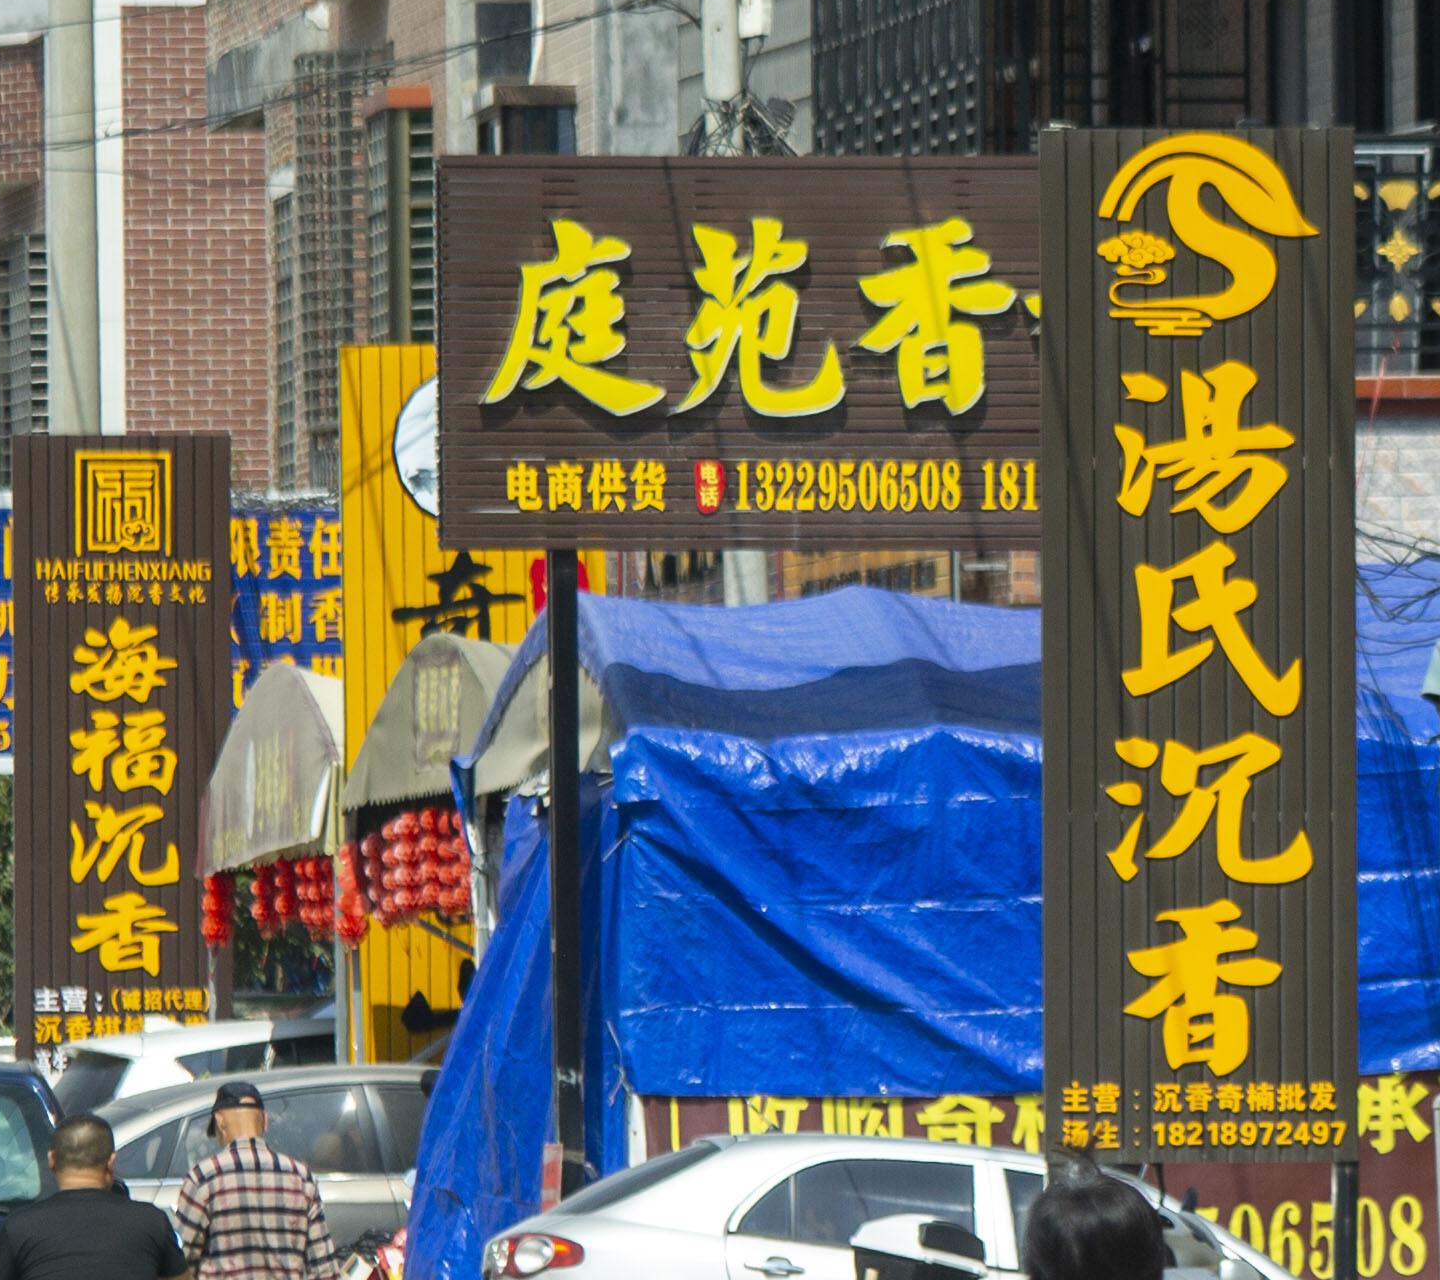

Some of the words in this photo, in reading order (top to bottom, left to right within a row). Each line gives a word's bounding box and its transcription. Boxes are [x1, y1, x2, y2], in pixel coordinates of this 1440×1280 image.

[479, 217, 1042, 417] 庭苑香
[505, 459, 668, 513] 电商供货
[735, 458, 963, 513] 13229506508
[70, 617, 182, 977] 海福沉香
[1061, 1080, 1141, 1114] 主营：
[1152, 1081, 1338, 1114] 沉香奇楠批发
[1061, 1119, 1141, 1149] 汤生：
[1152, 1119, 1348, 1147] 18218972497
